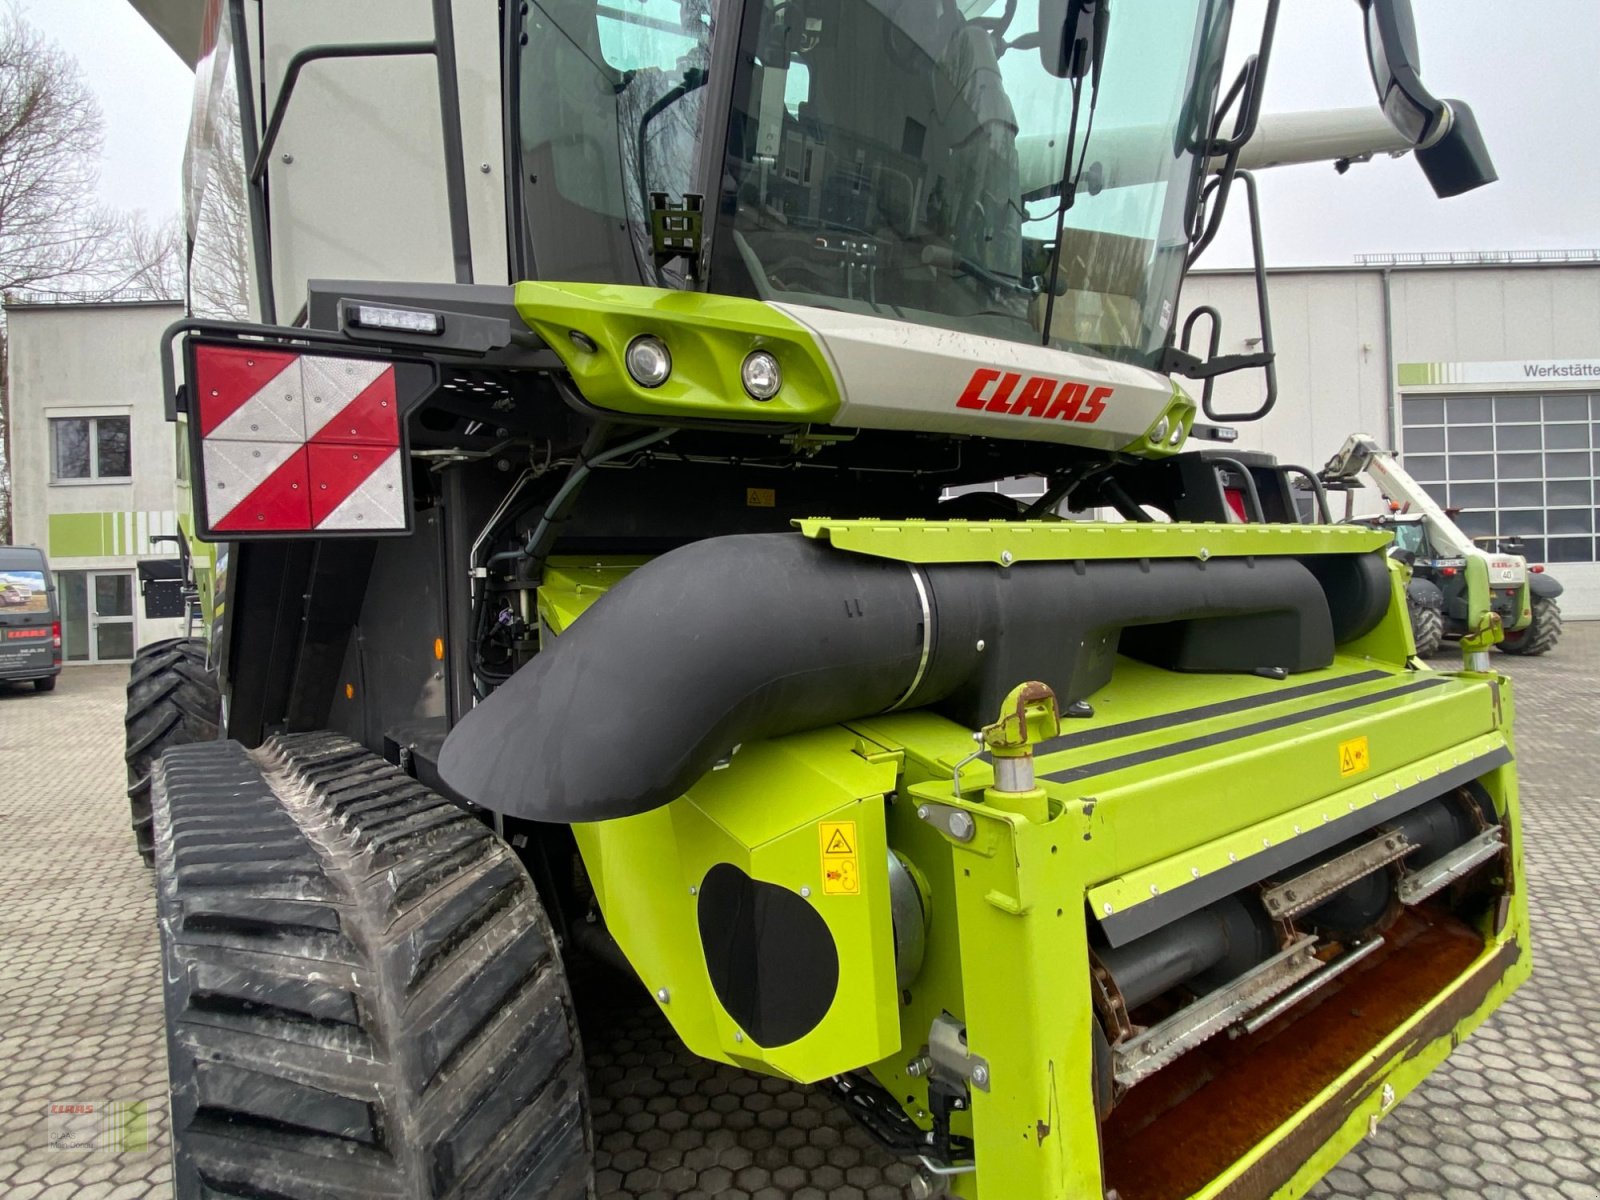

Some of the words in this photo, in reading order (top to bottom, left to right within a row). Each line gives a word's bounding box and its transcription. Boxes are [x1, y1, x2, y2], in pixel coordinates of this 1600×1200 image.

[1523, 364, 1600, 377] Werkstätte
[955, 367, 1114, 424] CLAAS
[1503, 571, 1512, 579] 40
